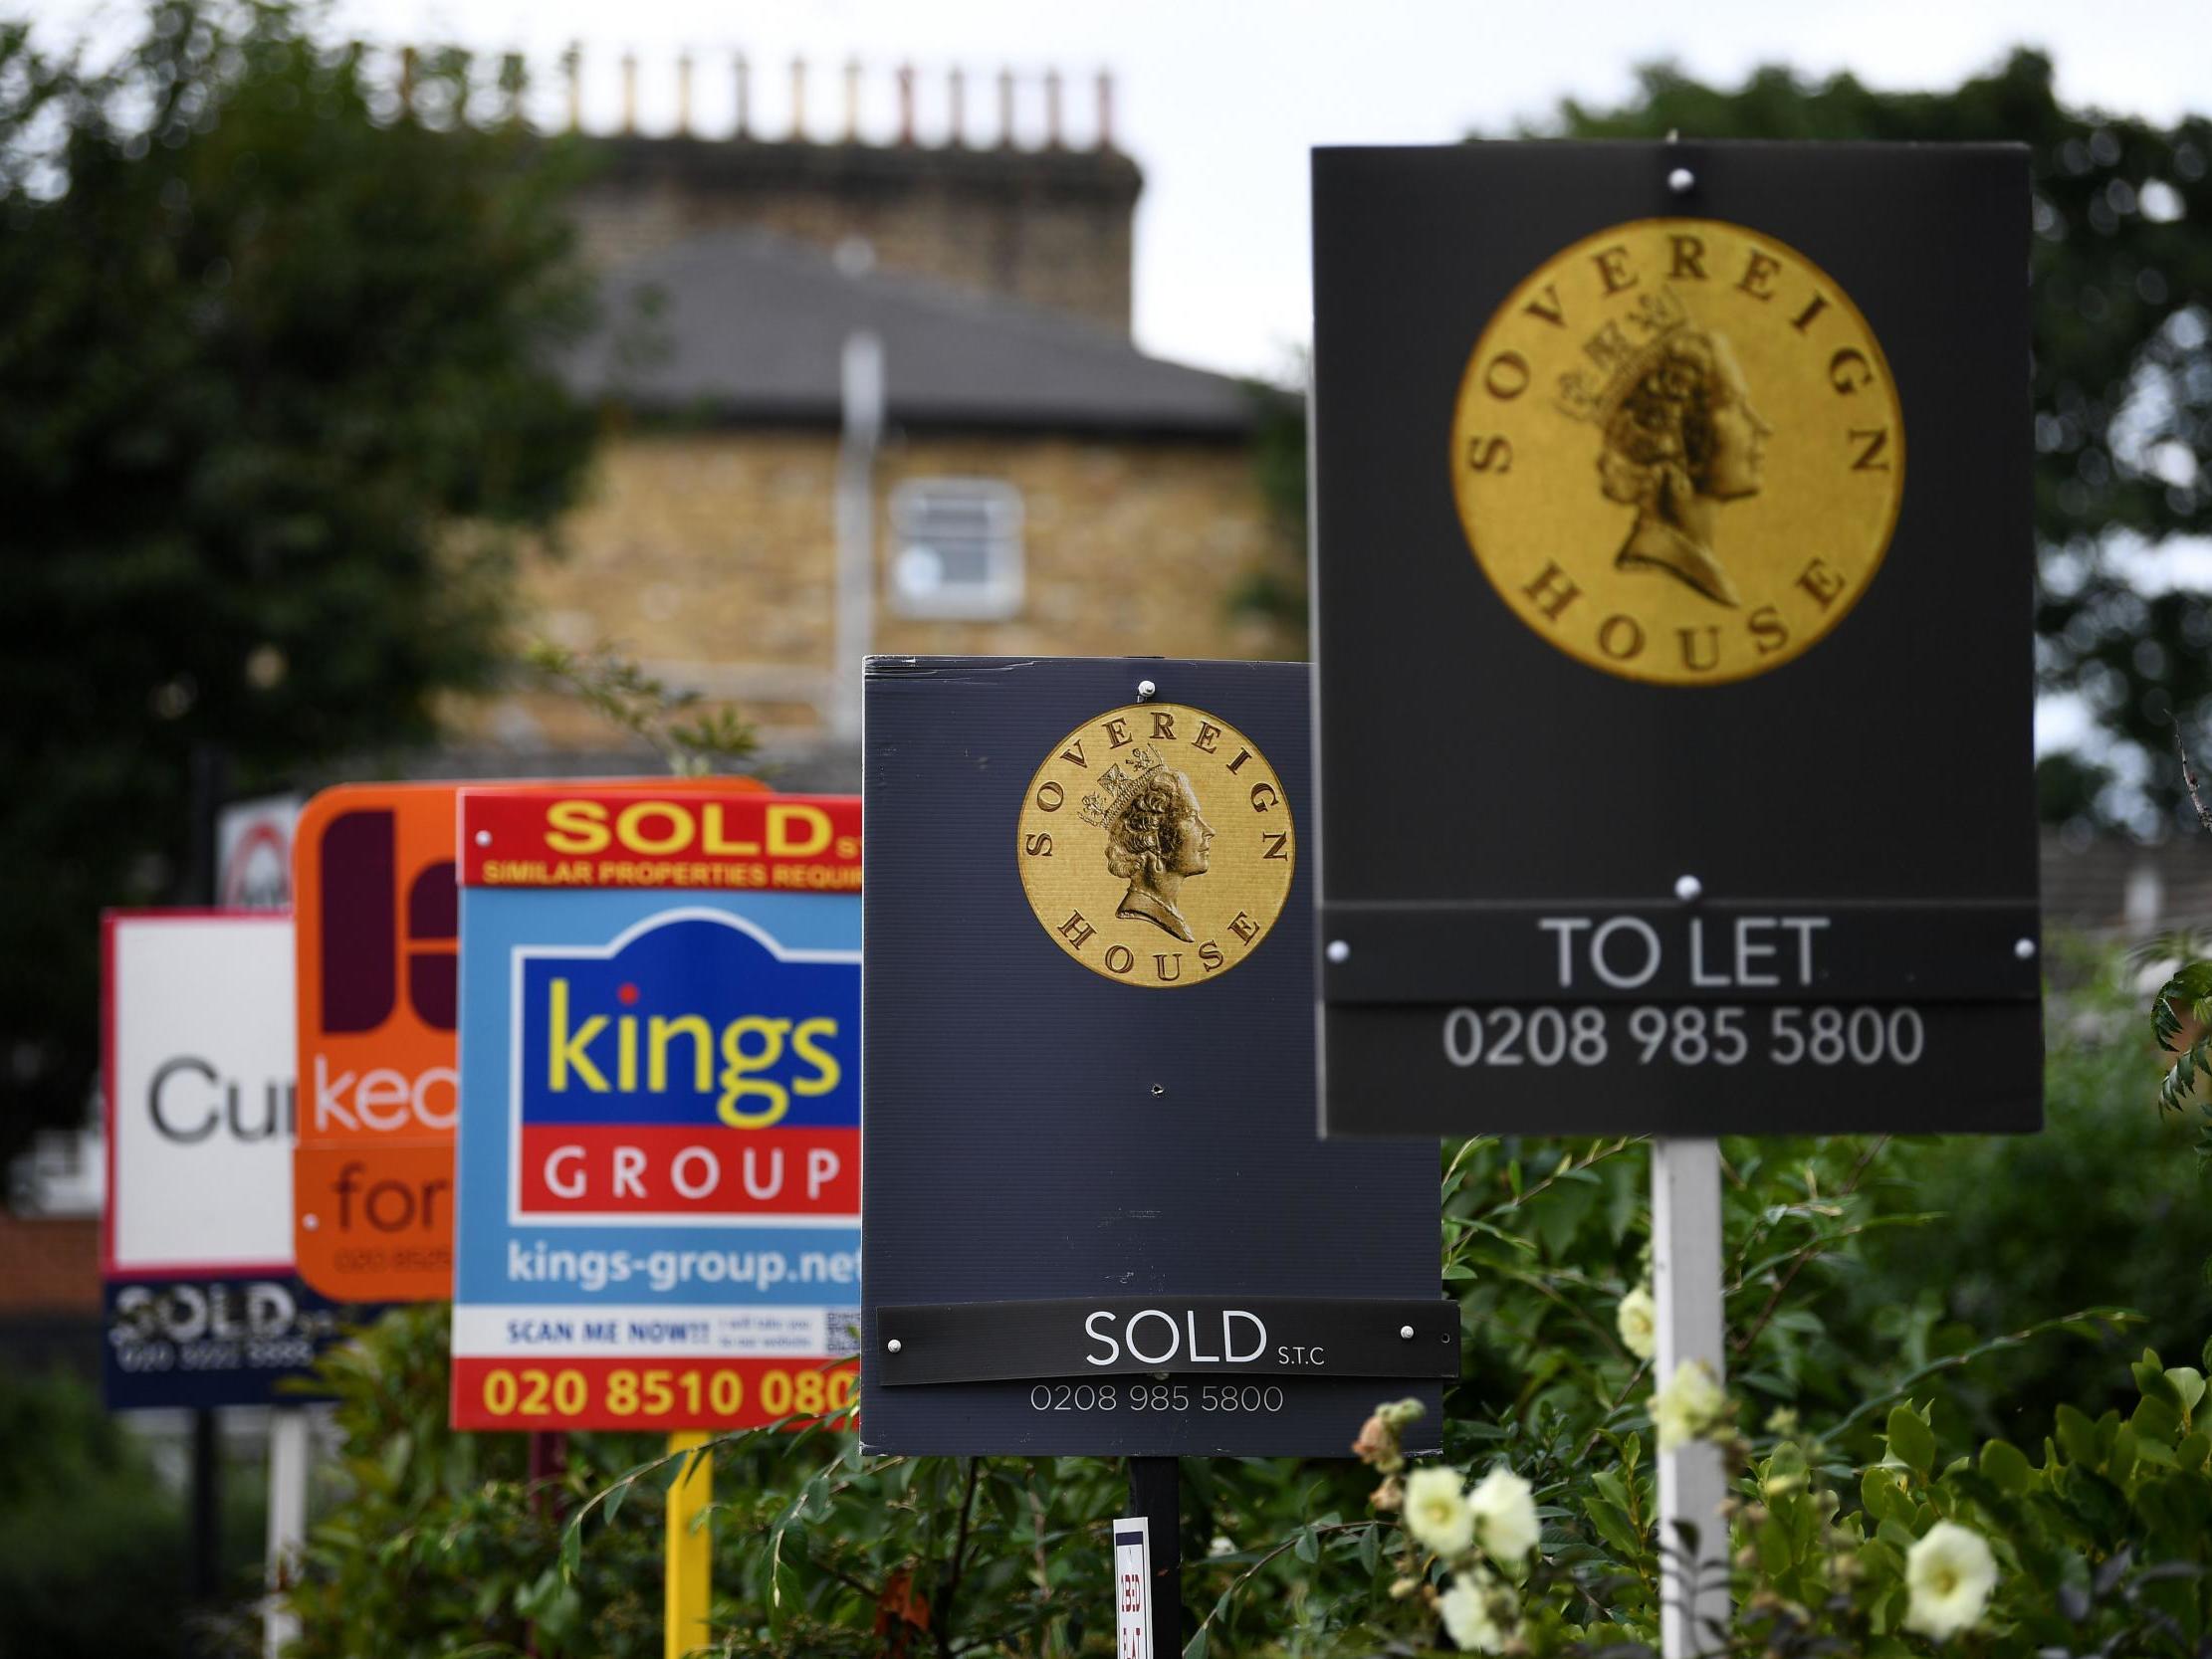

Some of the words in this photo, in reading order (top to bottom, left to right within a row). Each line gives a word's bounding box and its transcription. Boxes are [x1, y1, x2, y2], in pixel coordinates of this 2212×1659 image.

[1468, 234, 1890, 476] SOVEREIGN
[1521, 557, 1846, 673] HOUSE
[1026, 712, 1288, 861] SOVEREIGN
[545, 799, 833, 858] SOLD
[483, 859, 594, 885] SIMILAR
[598, 860, 769, 888] PROPERTIES
[1057, 910, 1260, 981] HOUSE
[1539, 916, 1660, 988] TO
[1690, 917, 1831, 986] LET
[549, 976, 841, 1131] kings
[1442, 1006, 1609, 1067] 0208
[1629, 1006, 1748, 1066] 985
[1771, 1006, 1924, 1065] 5800
[332, 1161, 449, 1233] for
[544, 1144, 840, 1200] GROUP
[508, 1320, 573, 1344] SCAN
[582, 1320, 617, 1344] ME
[1085, 1309, 1267, 1365] SOLD
[483, 1368, 588, 1417] 020
[605, 1369, 743, 1417] 8510
[1030, 1384, 1117, 1411] 0208
[1130, 1385, 1189, 1411] 985
[1202, 1385, 1283, 1412] 5800
